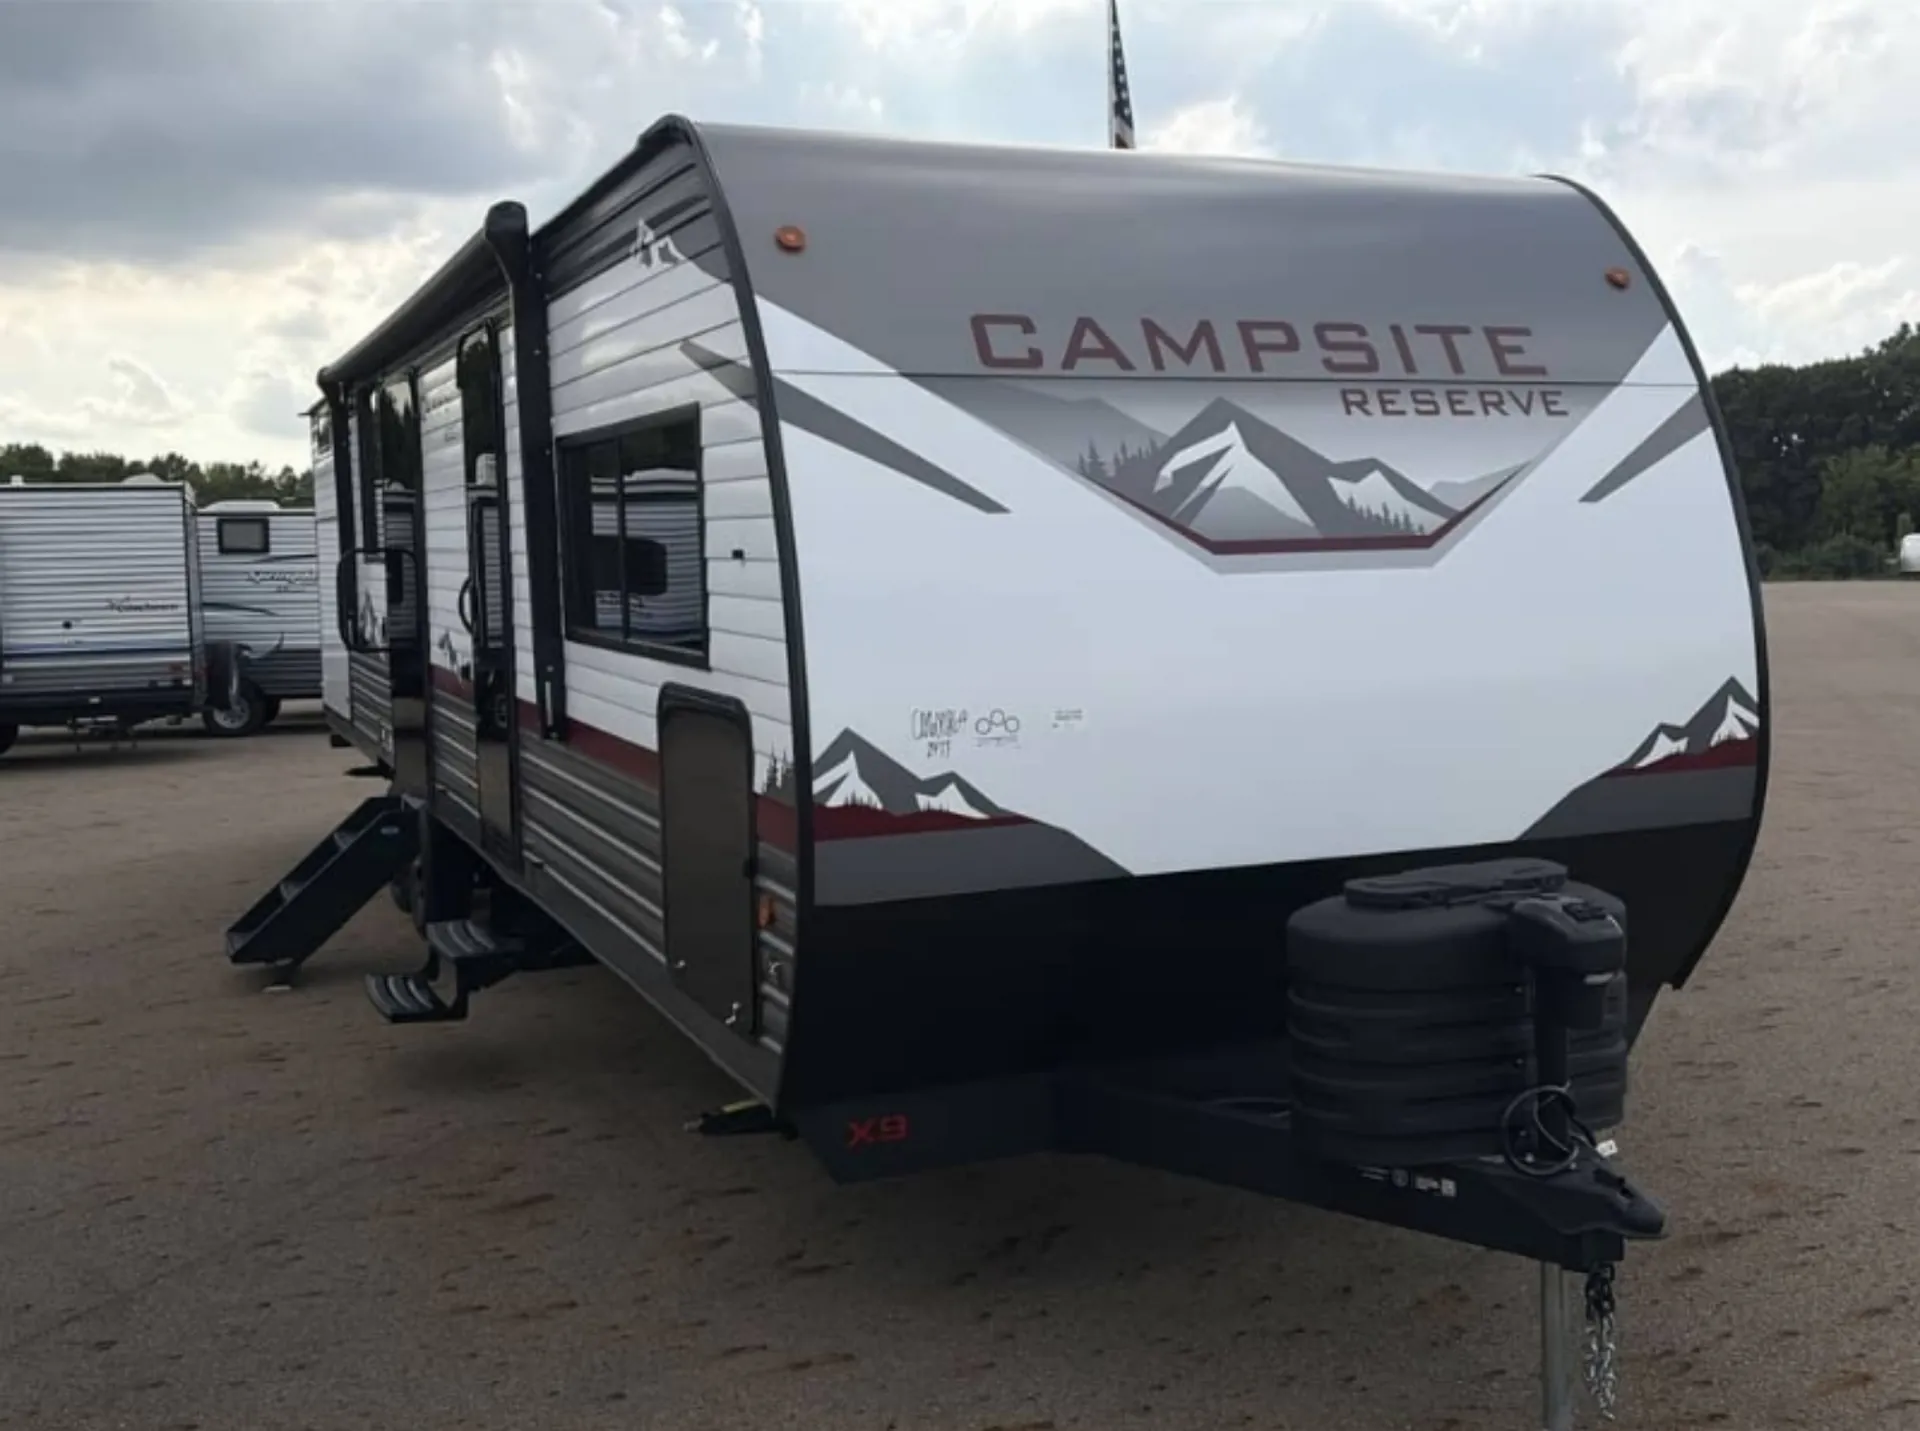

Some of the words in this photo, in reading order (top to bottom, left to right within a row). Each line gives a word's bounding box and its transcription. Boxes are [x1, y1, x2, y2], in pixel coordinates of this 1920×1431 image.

[969, 313, 1549, 376] CAMPSITE
[1339, 387, 1569, 417] RESERVE
[846, 1114, 909, 1148] X9
